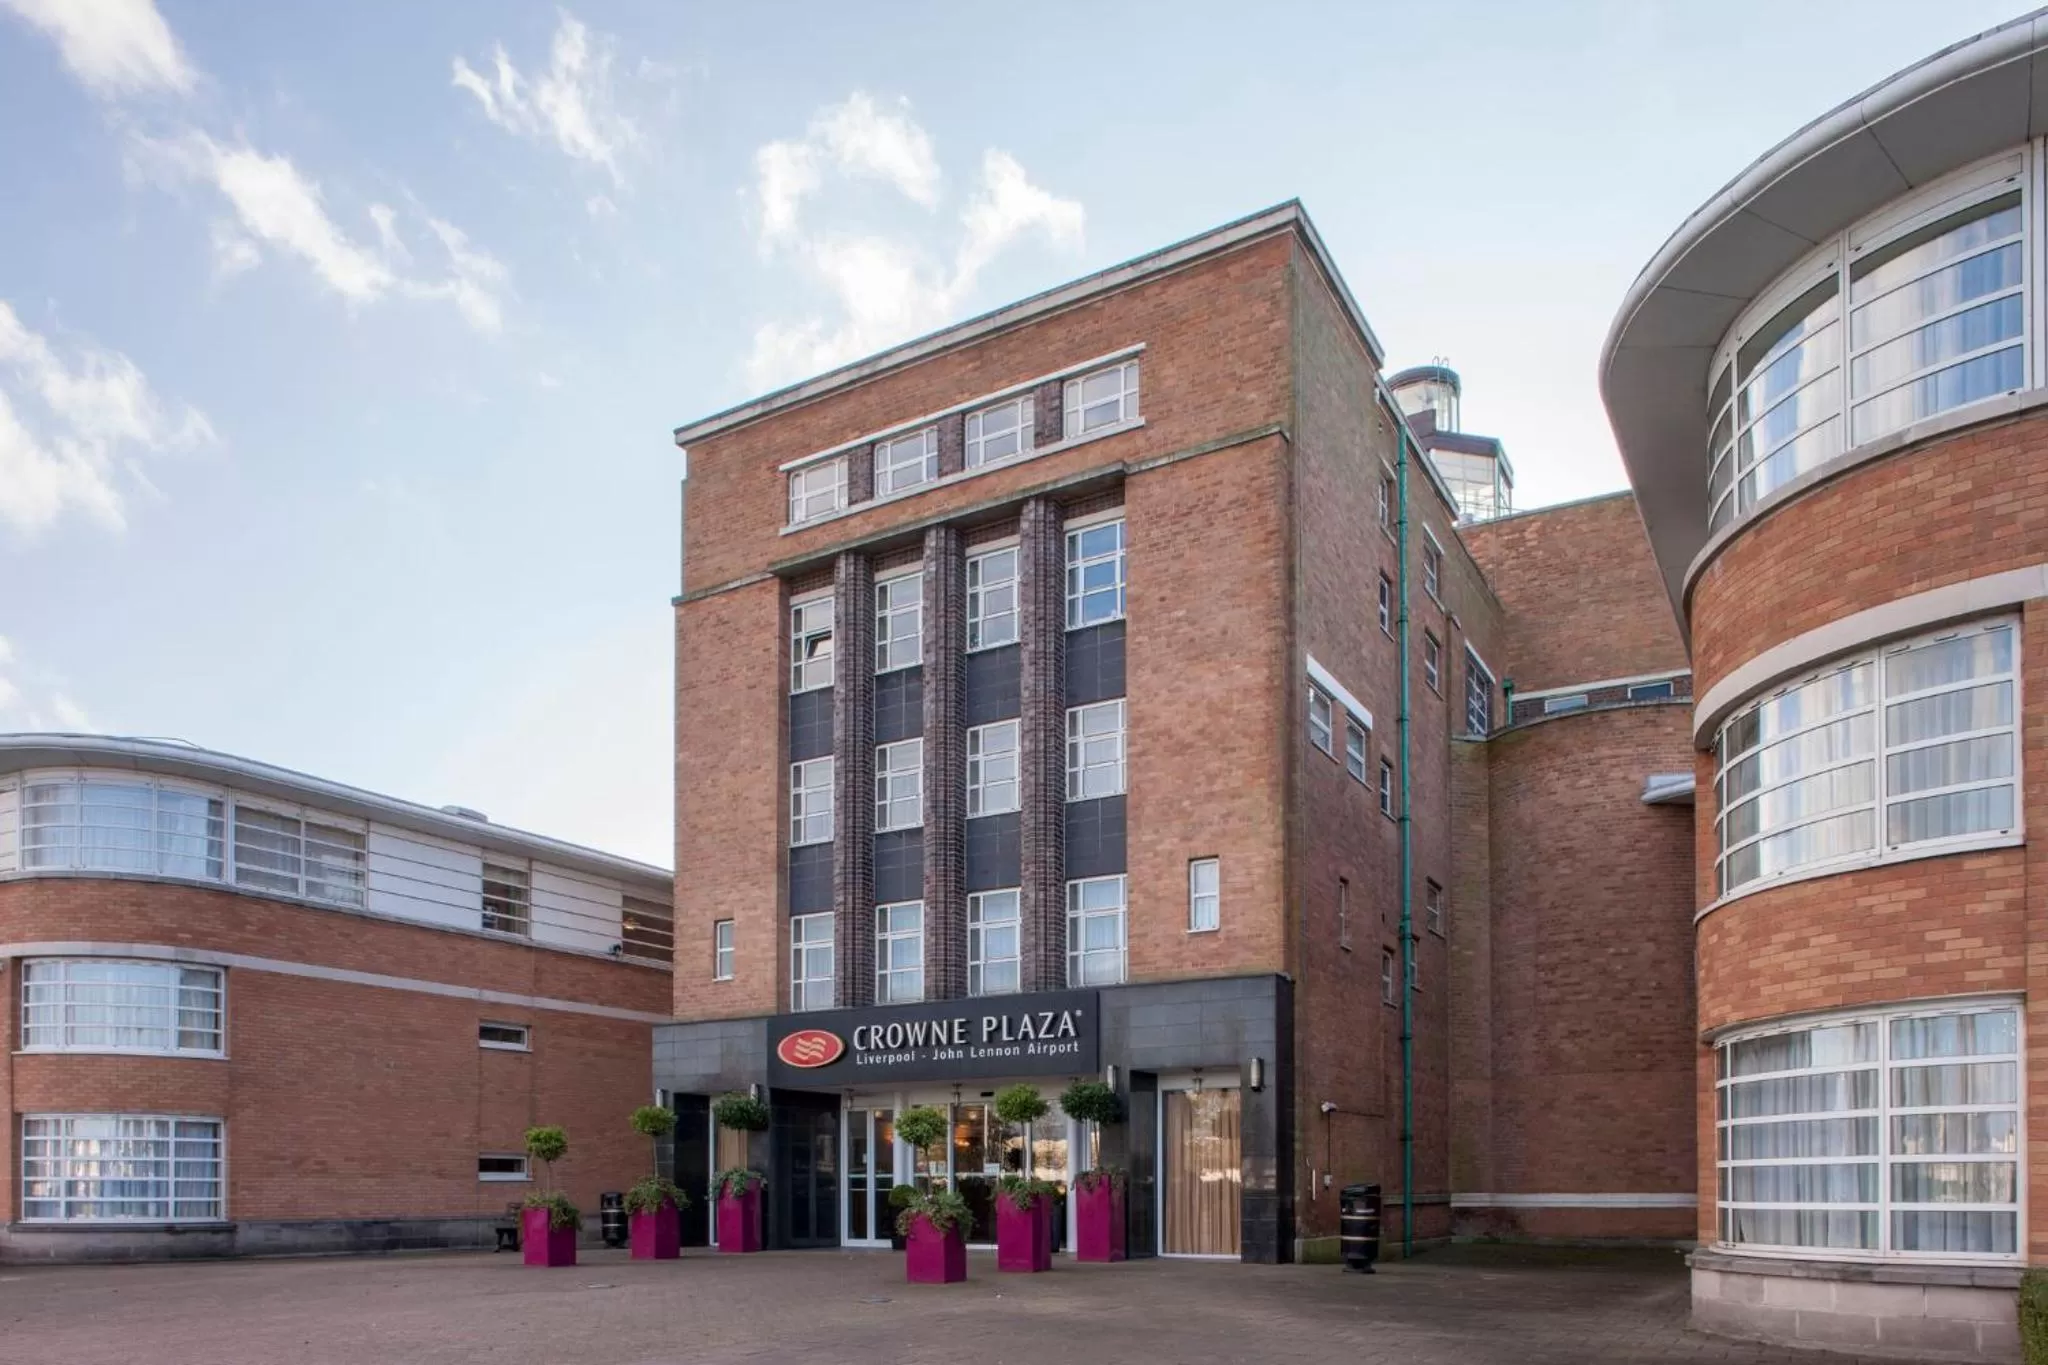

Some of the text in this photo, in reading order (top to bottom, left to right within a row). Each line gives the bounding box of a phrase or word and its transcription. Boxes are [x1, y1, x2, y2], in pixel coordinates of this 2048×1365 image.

[853, 1010, 1077, 1051] CROWNE PLAZA
[856, 1050, 916, 1065] Liverpool
[932, 1048, 964, 1060] John
[970, 1045, 1020, 1057] Lennon
[1027, 1041, 1080, 1055] Airport
